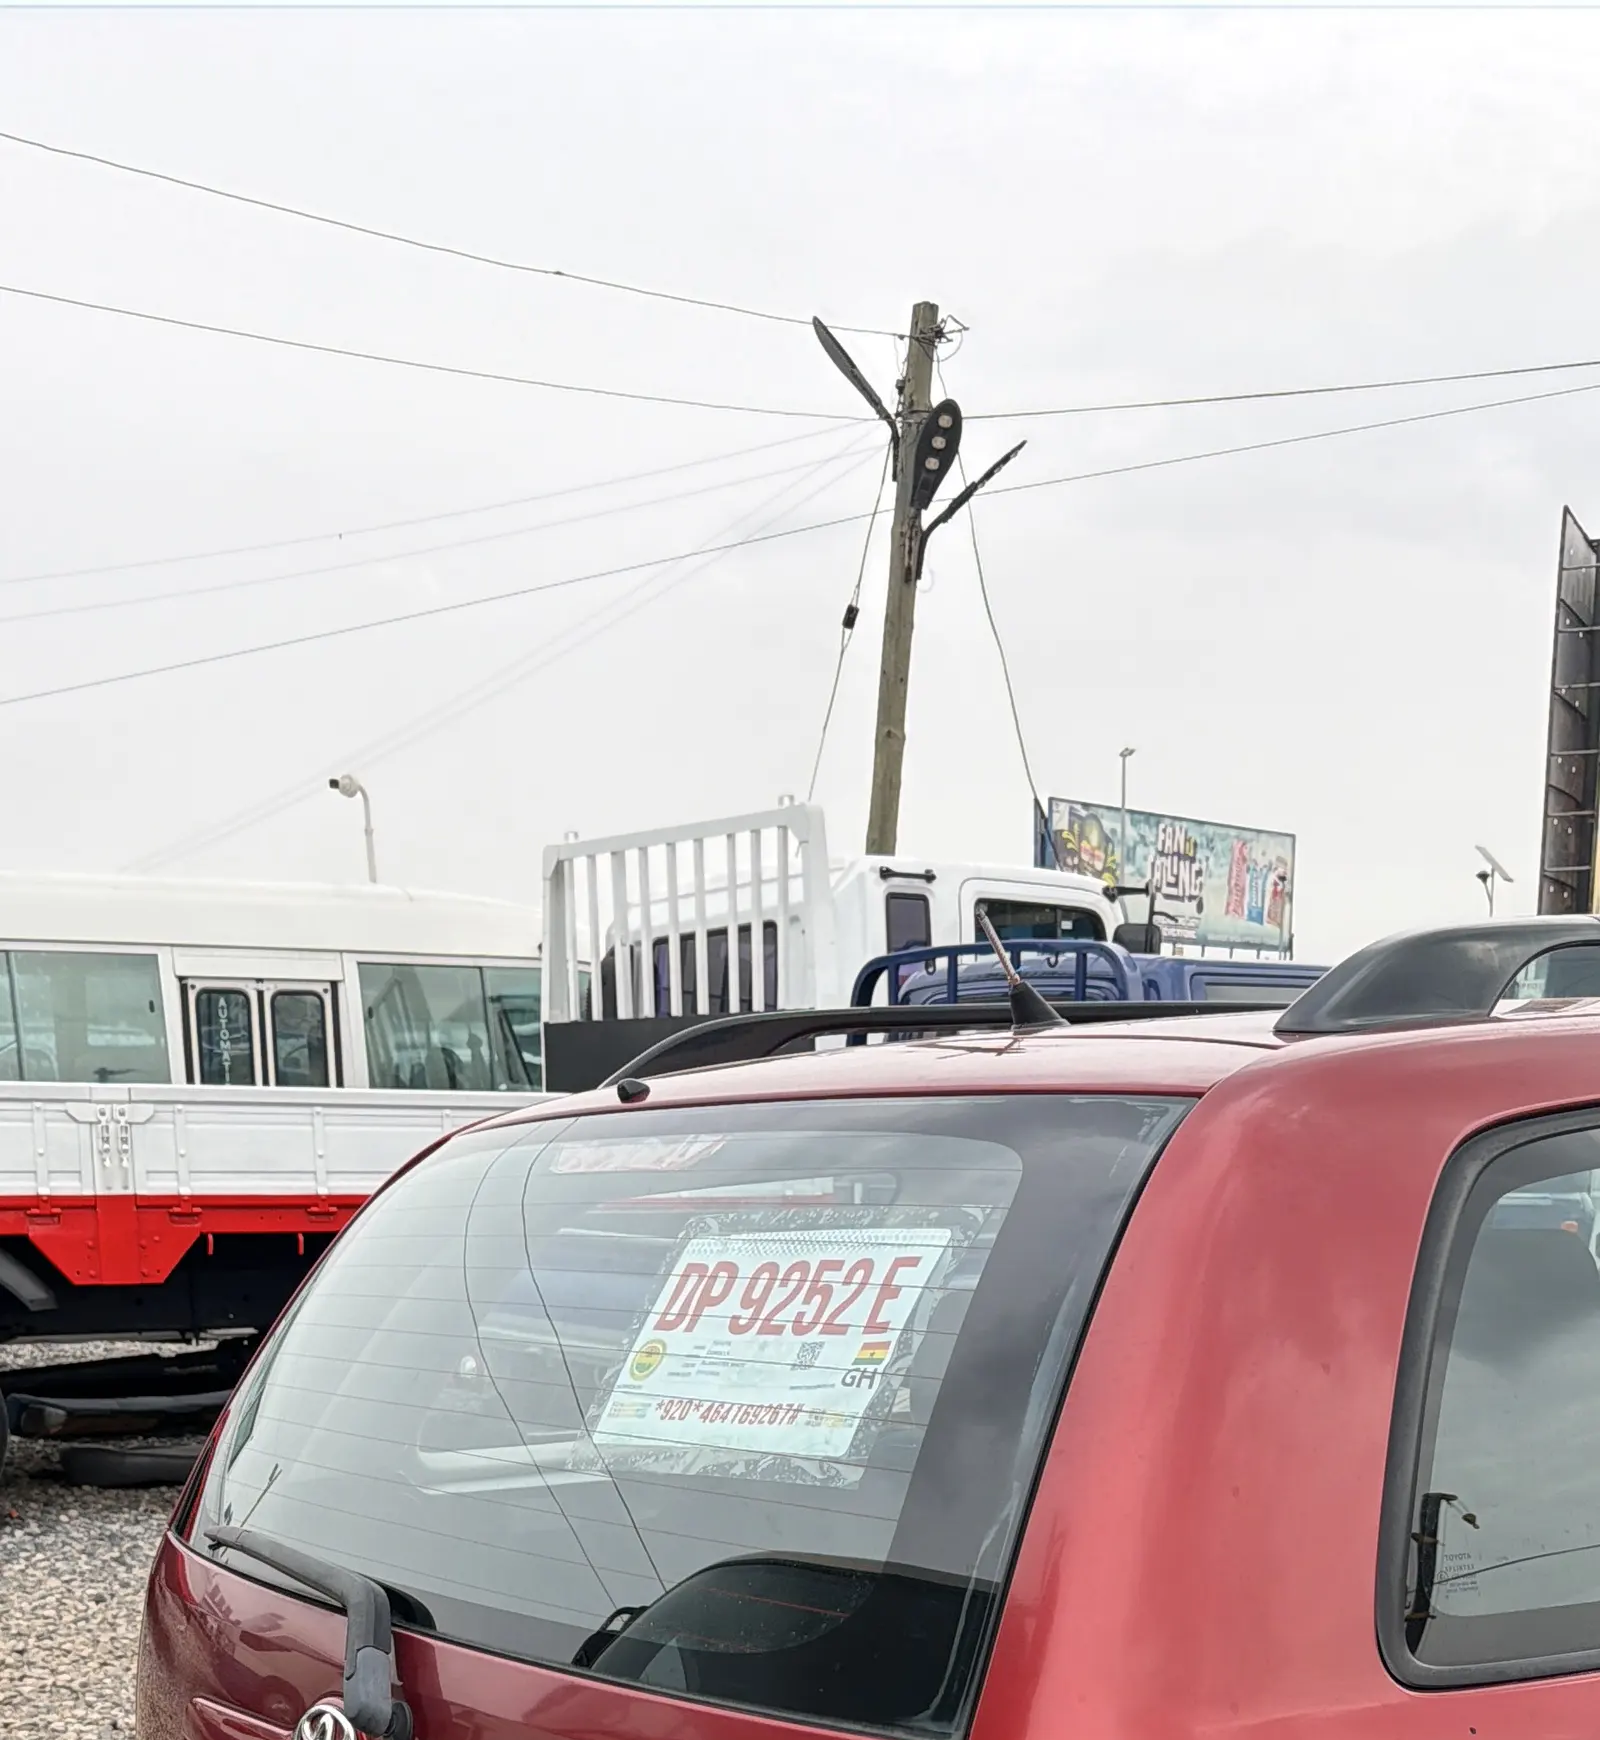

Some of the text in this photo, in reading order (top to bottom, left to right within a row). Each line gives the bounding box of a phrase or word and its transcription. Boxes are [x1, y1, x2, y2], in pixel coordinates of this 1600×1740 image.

[1158, 823, 1187, 853] FAN
[217, 996, 232, 1085] AUTOMATI
[653, 1256, 922, 1336] DP 9252 E
[841, 1367, 879, 1390] GH
